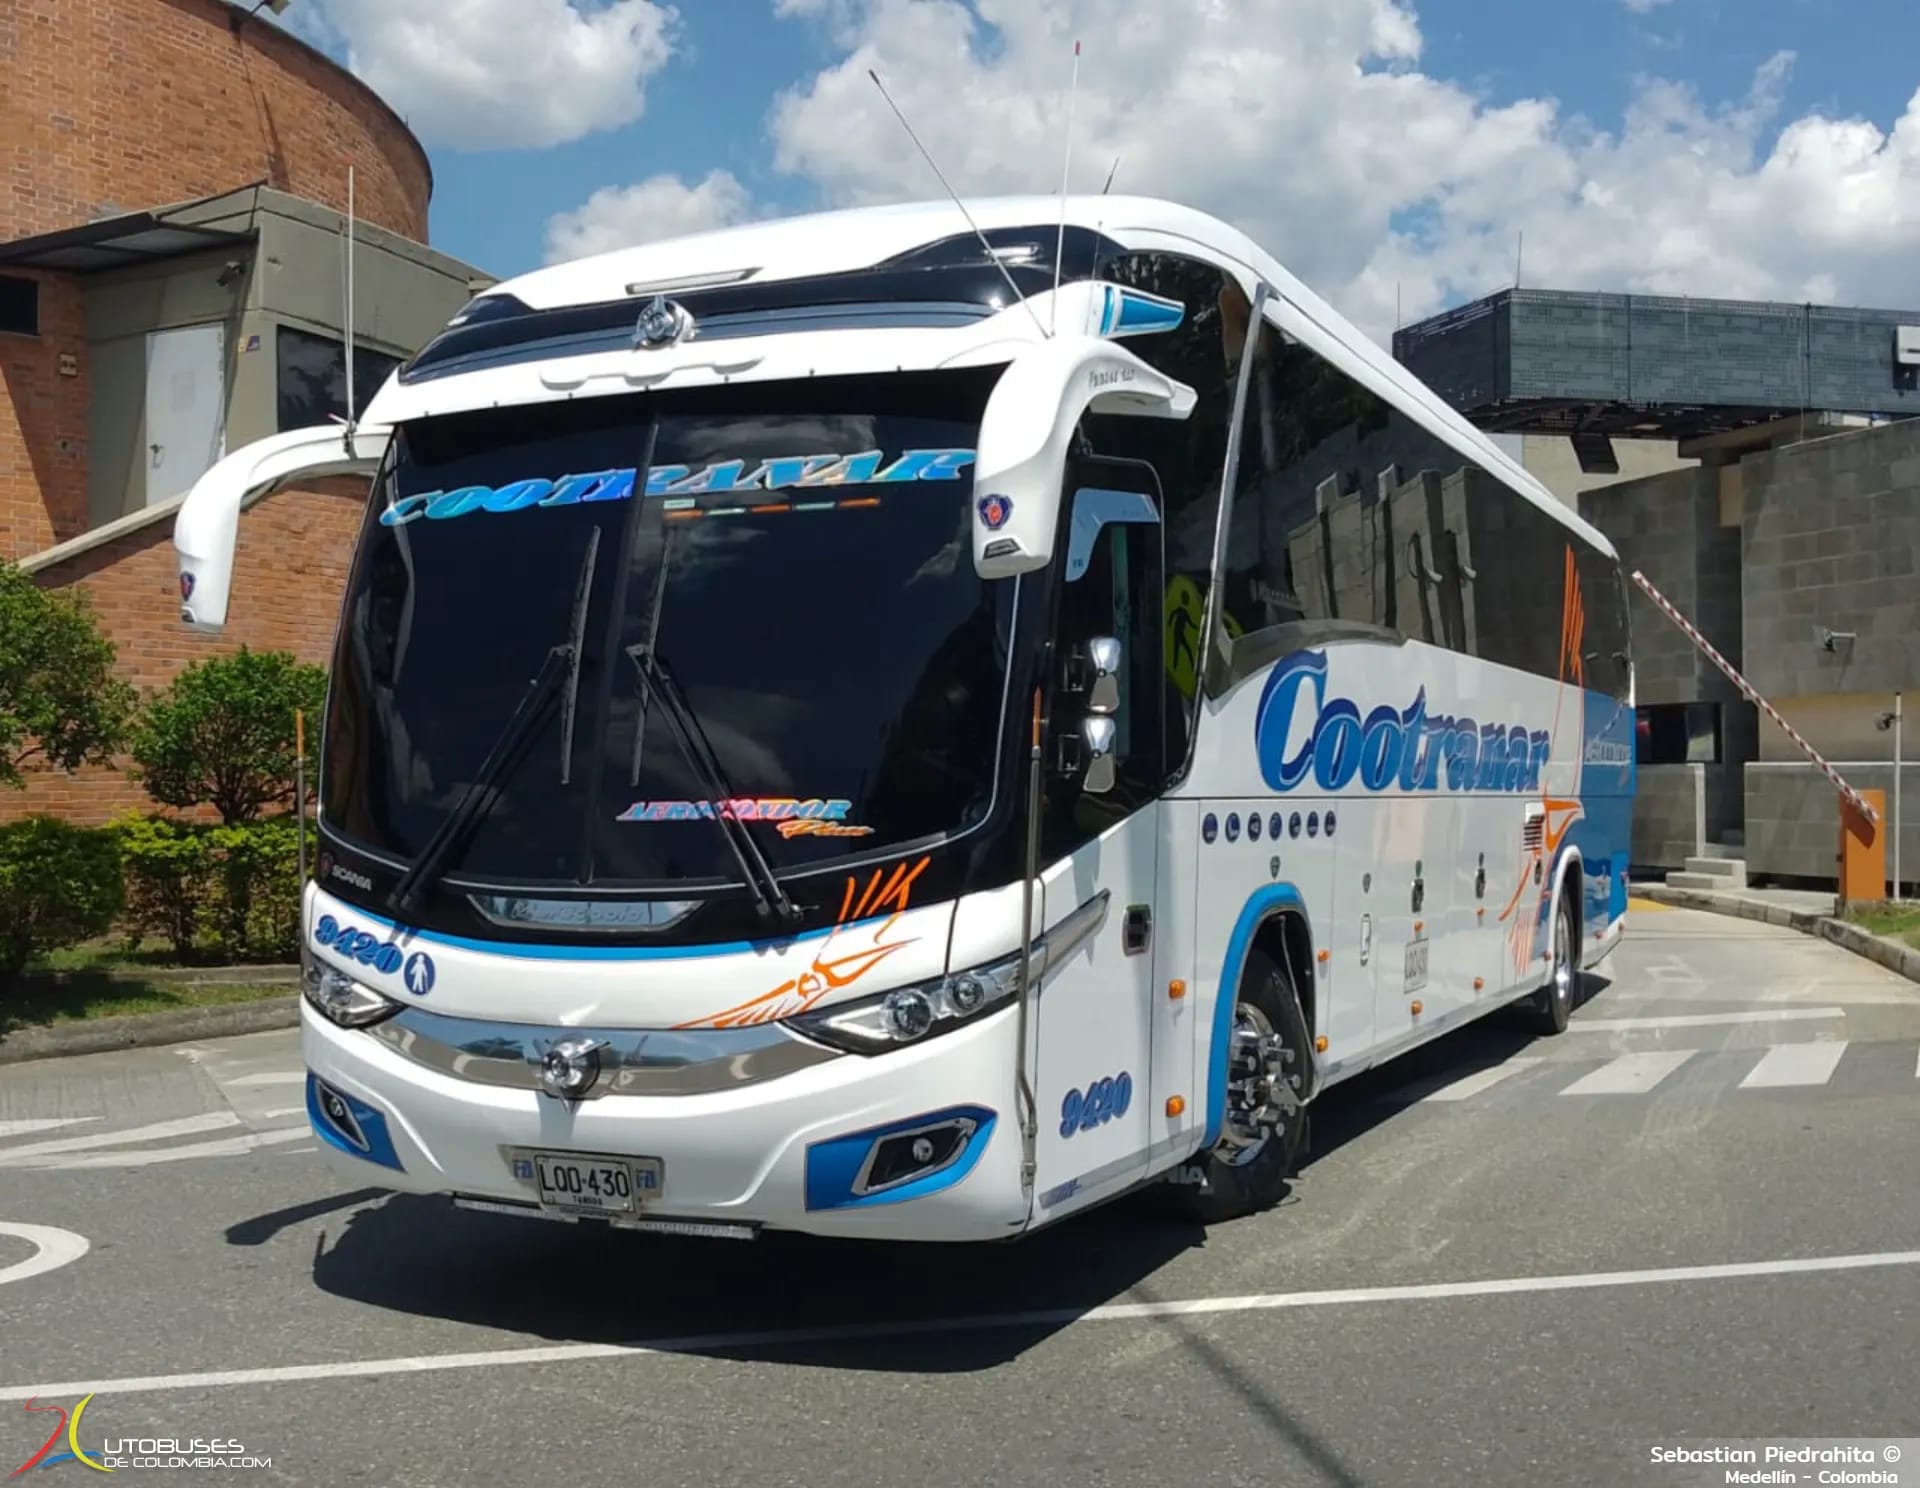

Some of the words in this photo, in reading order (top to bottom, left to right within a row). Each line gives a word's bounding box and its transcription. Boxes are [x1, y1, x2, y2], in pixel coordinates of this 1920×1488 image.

[379, 447, 976, 527] COOTRANAR
[1255, 648, 1550, 792] Cootranar
[332, 864, 372, 891] SCANIA
[314, 914, 404, 974] 9420
[1059, 1070, 1133, 1139] 9420
